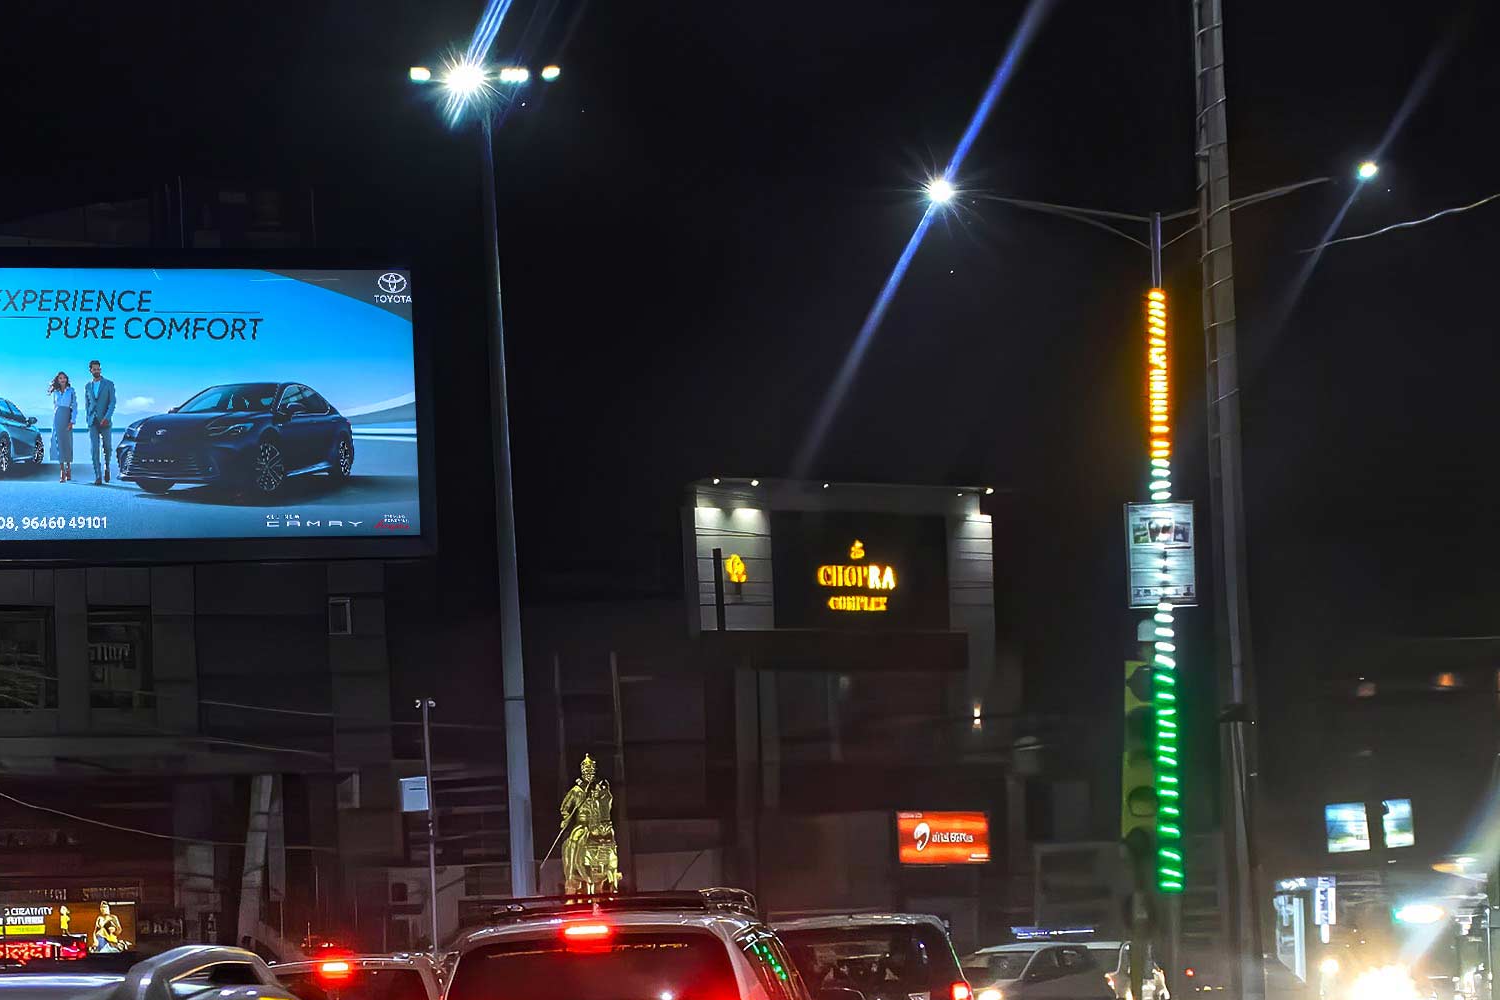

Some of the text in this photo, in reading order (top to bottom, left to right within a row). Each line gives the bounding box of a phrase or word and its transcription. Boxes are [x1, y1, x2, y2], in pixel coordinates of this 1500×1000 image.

[374, 294, 412, 304] TOYOTA
[45, 316, 264, 341] PURE COMFORT
[22, 516, 66, 529] 96460
[68, 516, 108, 529] 49101
[266, 520, 363, 528] CAMRY
[818, 565, 896, 590] CHOPRA
